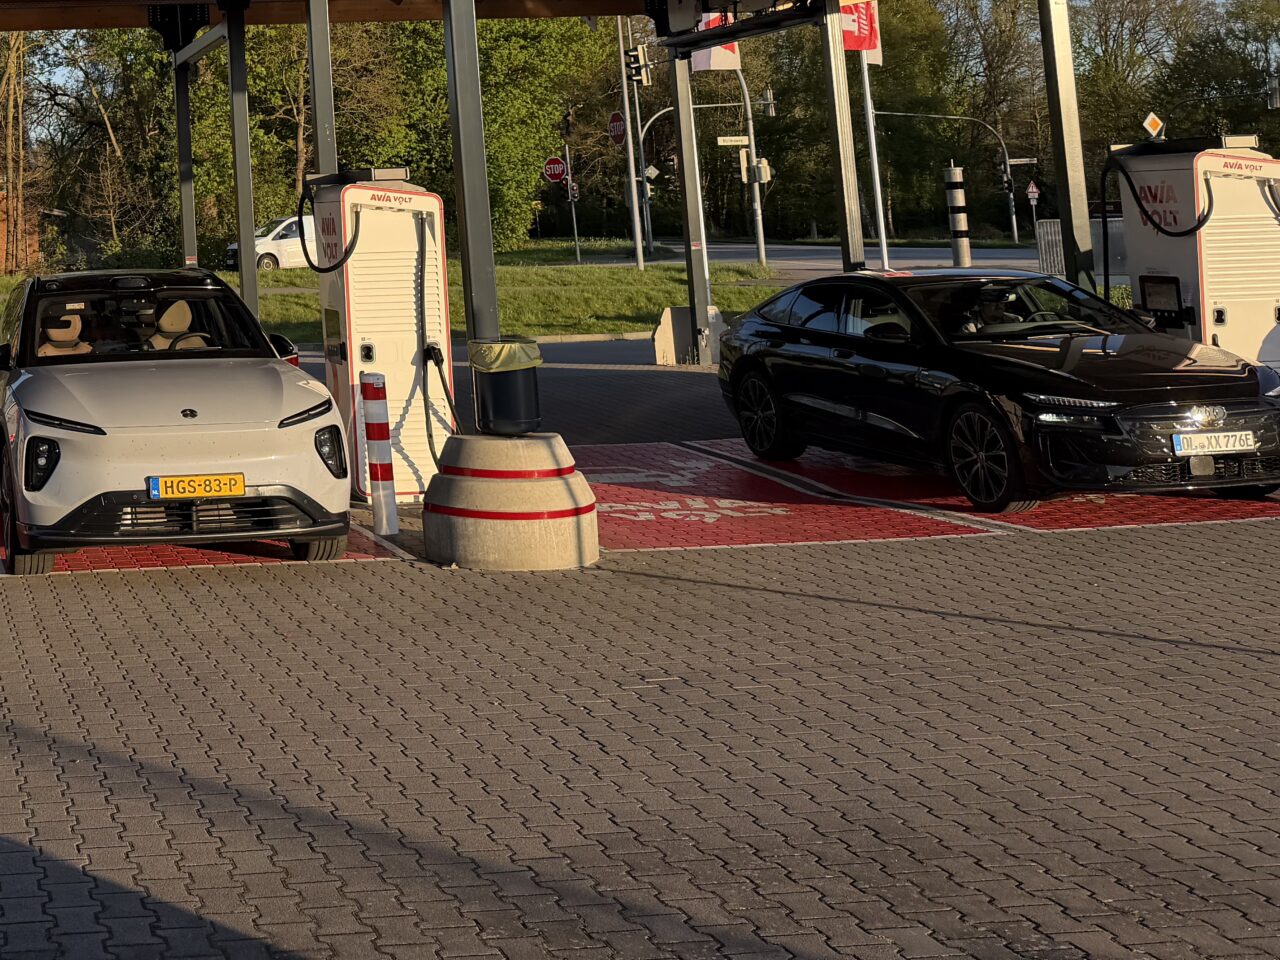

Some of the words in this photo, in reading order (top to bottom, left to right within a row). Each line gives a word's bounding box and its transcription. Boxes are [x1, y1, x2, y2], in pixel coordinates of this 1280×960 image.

[610, 122, 624, 136] STOP
[545, 164, 564, 175] STOP
[1244, 164, 1263, 173] VOLT
[393, 196, 413, 205] VOLT
[1182, 437, 1195, 451] OL
[1206, 435, 1222, 450] XX
[1224, 433, 1253, 449] 776E
[164, 477, 238, 495] HGS-83-P
